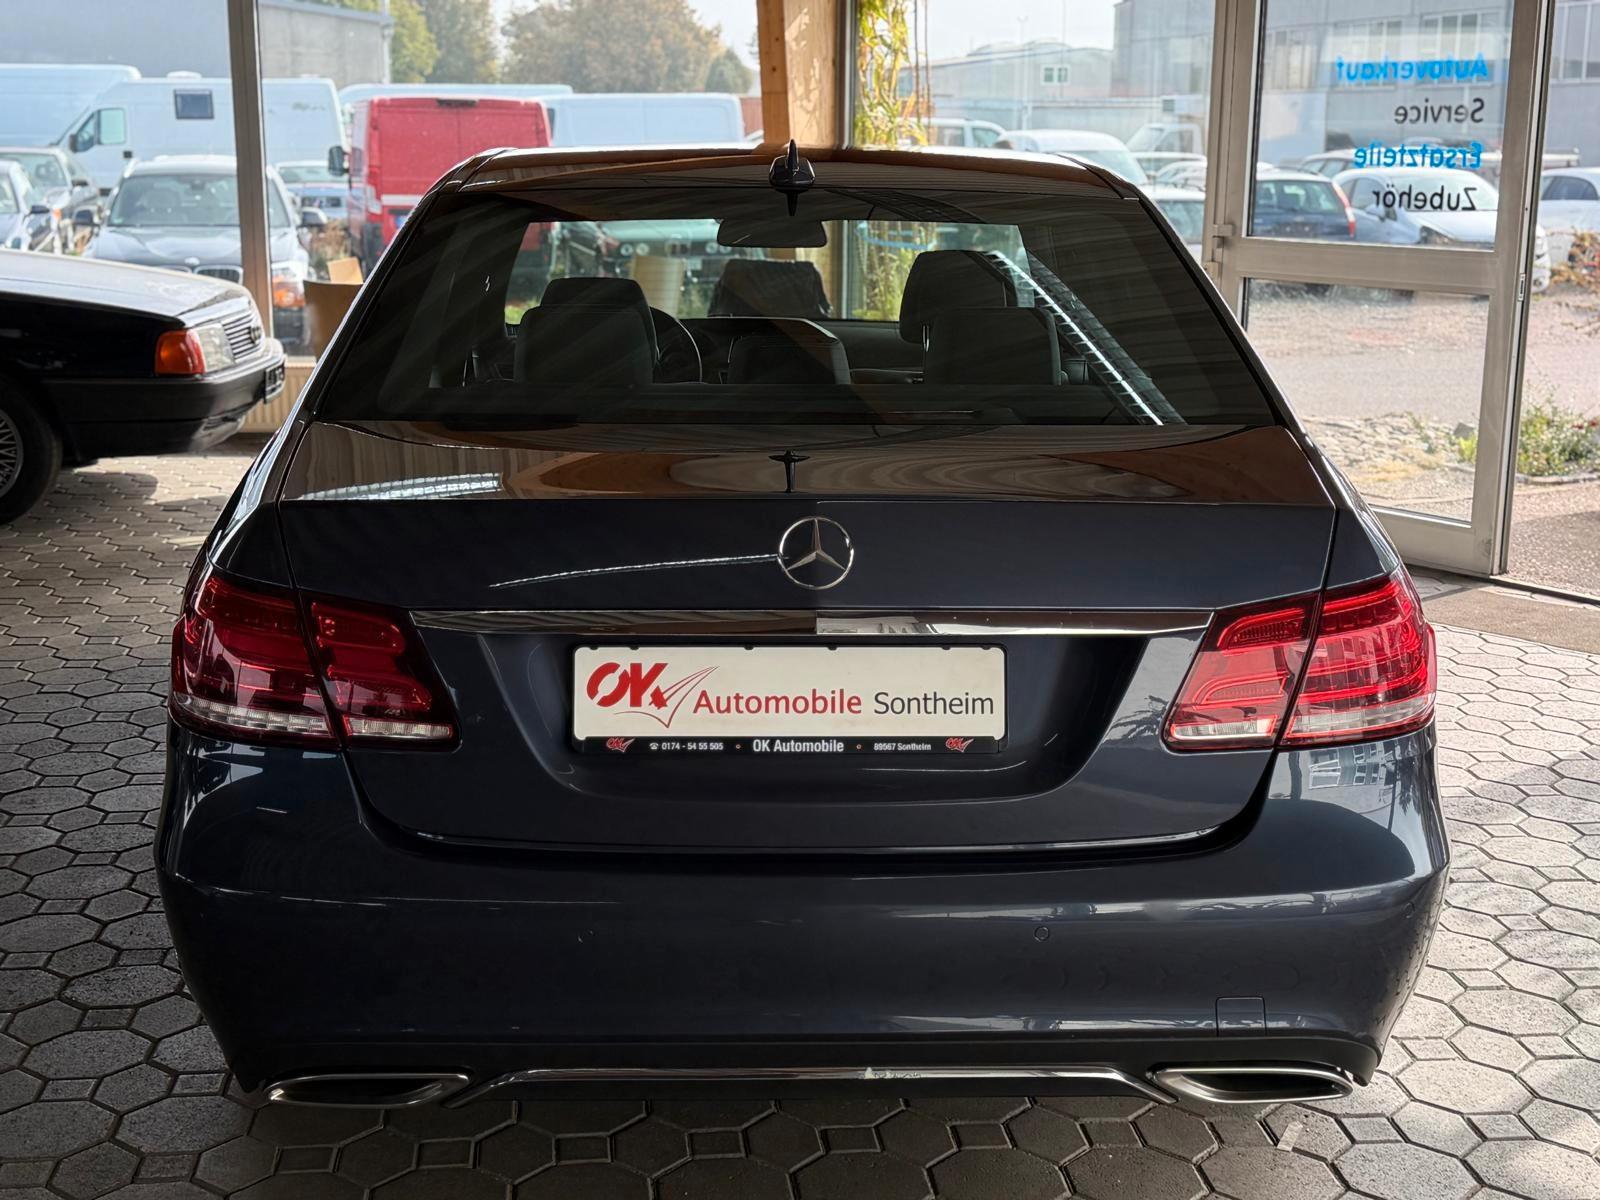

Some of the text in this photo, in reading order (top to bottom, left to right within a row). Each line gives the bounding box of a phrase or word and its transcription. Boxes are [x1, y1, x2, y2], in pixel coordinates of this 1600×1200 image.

[586, 662, 668, 709] OK
[693, 688, 994, 715] Automobile Sontheim
[661, 742, 680, 750] 0174
[687, 742, 697, 750] 54
[698, 742, 708, 750] 55
[752, 739, 845, 752] OK Automobile
[873, 742, 932, 751] 89567 Sontheim
